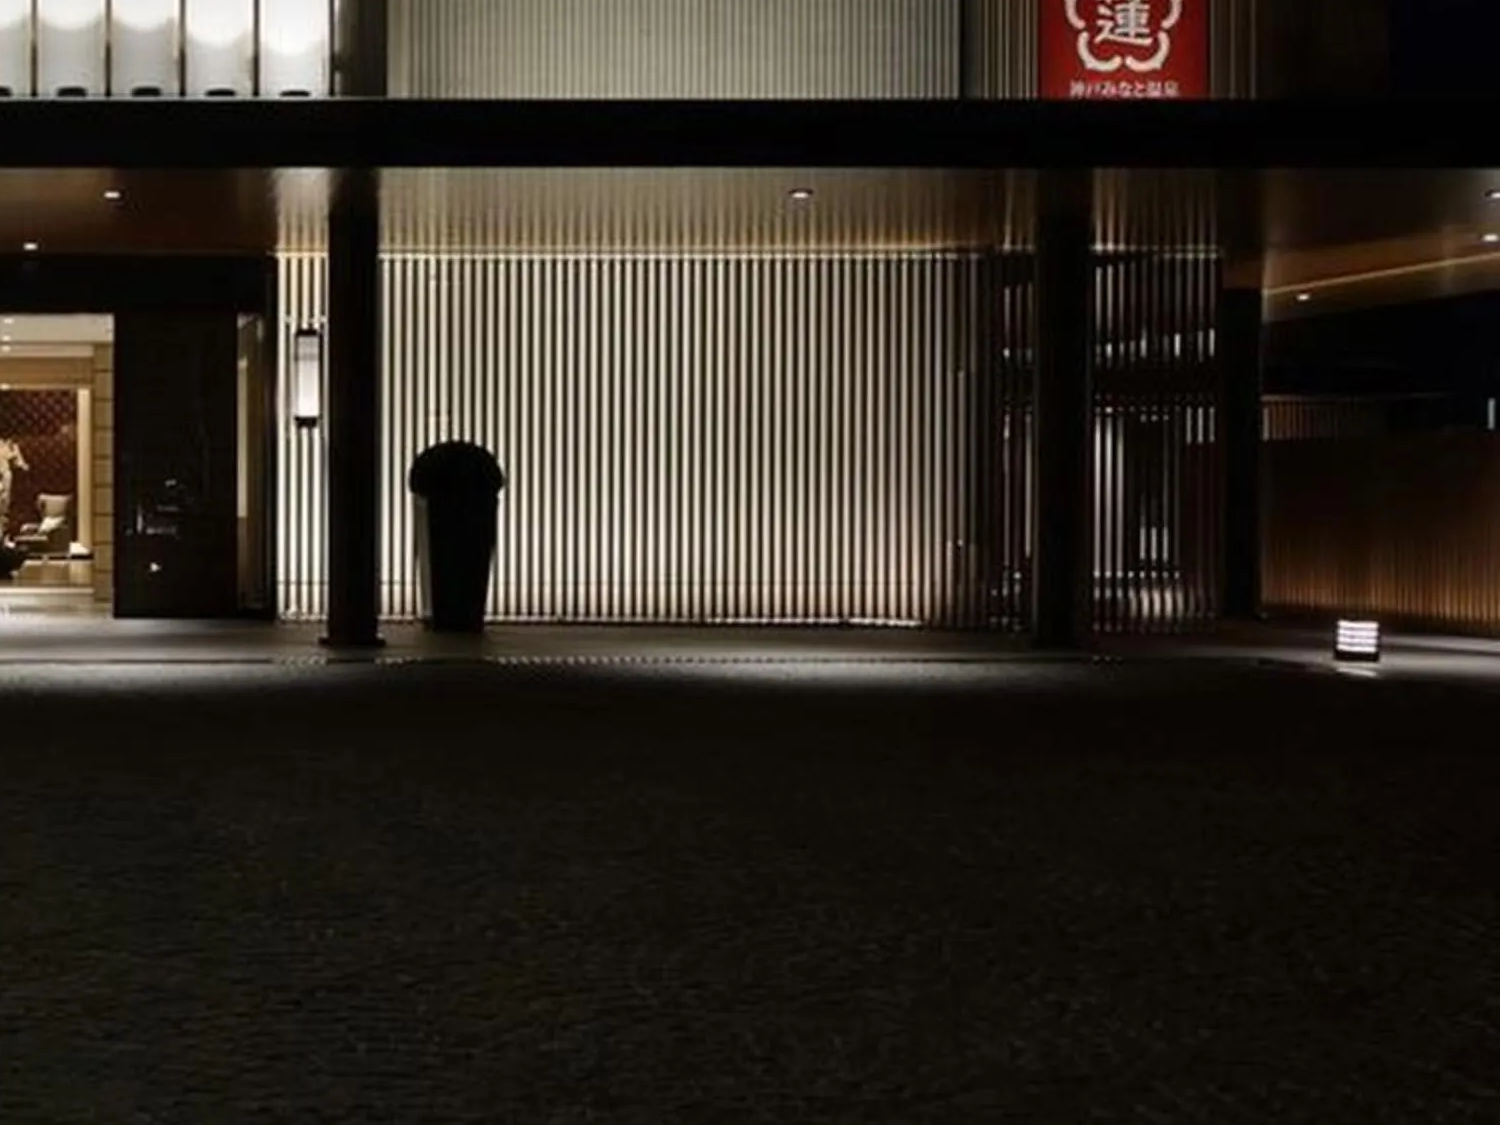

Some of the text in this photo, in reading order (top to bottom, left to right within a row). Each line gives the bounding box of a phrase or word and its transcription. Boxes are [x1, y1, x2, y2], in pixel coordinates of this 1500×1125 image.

[1069, 80, 1180, 100] 神戸みなと温泉
